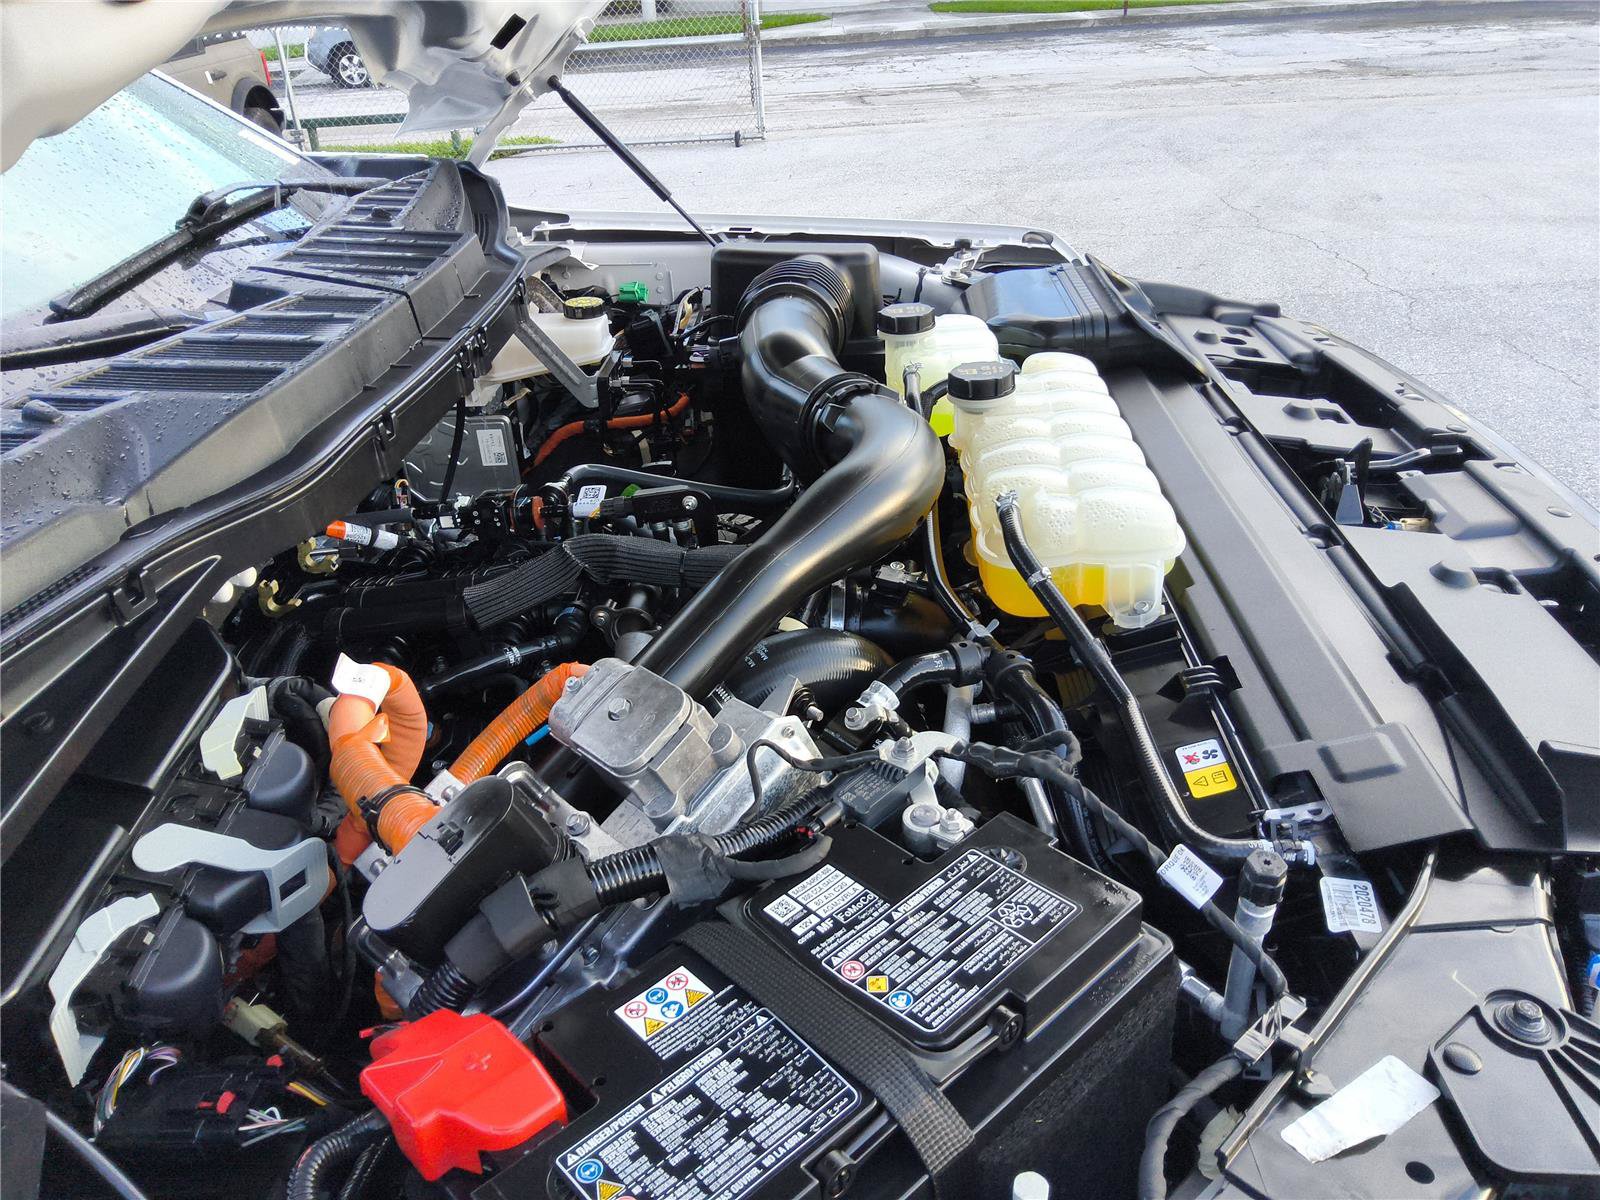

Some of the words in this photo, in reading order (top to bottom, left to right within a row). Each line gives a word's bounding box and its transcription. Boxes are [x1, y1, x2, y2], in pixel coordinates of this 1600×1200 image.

[1157, 853, 1181, 877] ORQUE
[820, 886, 861, 915] AGM/VRLA
[821, 891, 835, 901] Ah
[832, 881, 849, 893] C20
[1353, 884, 1376, 925] 2020478
[835, 892, 877, 921] FoMoCo
[835, 919, 891, 960] DANGER/POISON
[896, 877, 947, 914] PELIGRO/VENENO
[797, 918, 815, 931] 12V
[815, 917, 838, 934] MF
[916, 1005, 933, 1018] Lead
[928, 996, 944, 1008] Acid
[574, 1101, 647, 1158] DANGER/POISON
[657, 1045, 724, 1097] PELIGRO/VENENO
[727, 1164, 766, 1194] OUVRIR.
[760, 1154, 777, 1168] NO
[771, 1145, 788, 1159] LA
[782, 1129, 809, 1150] ABRA.
